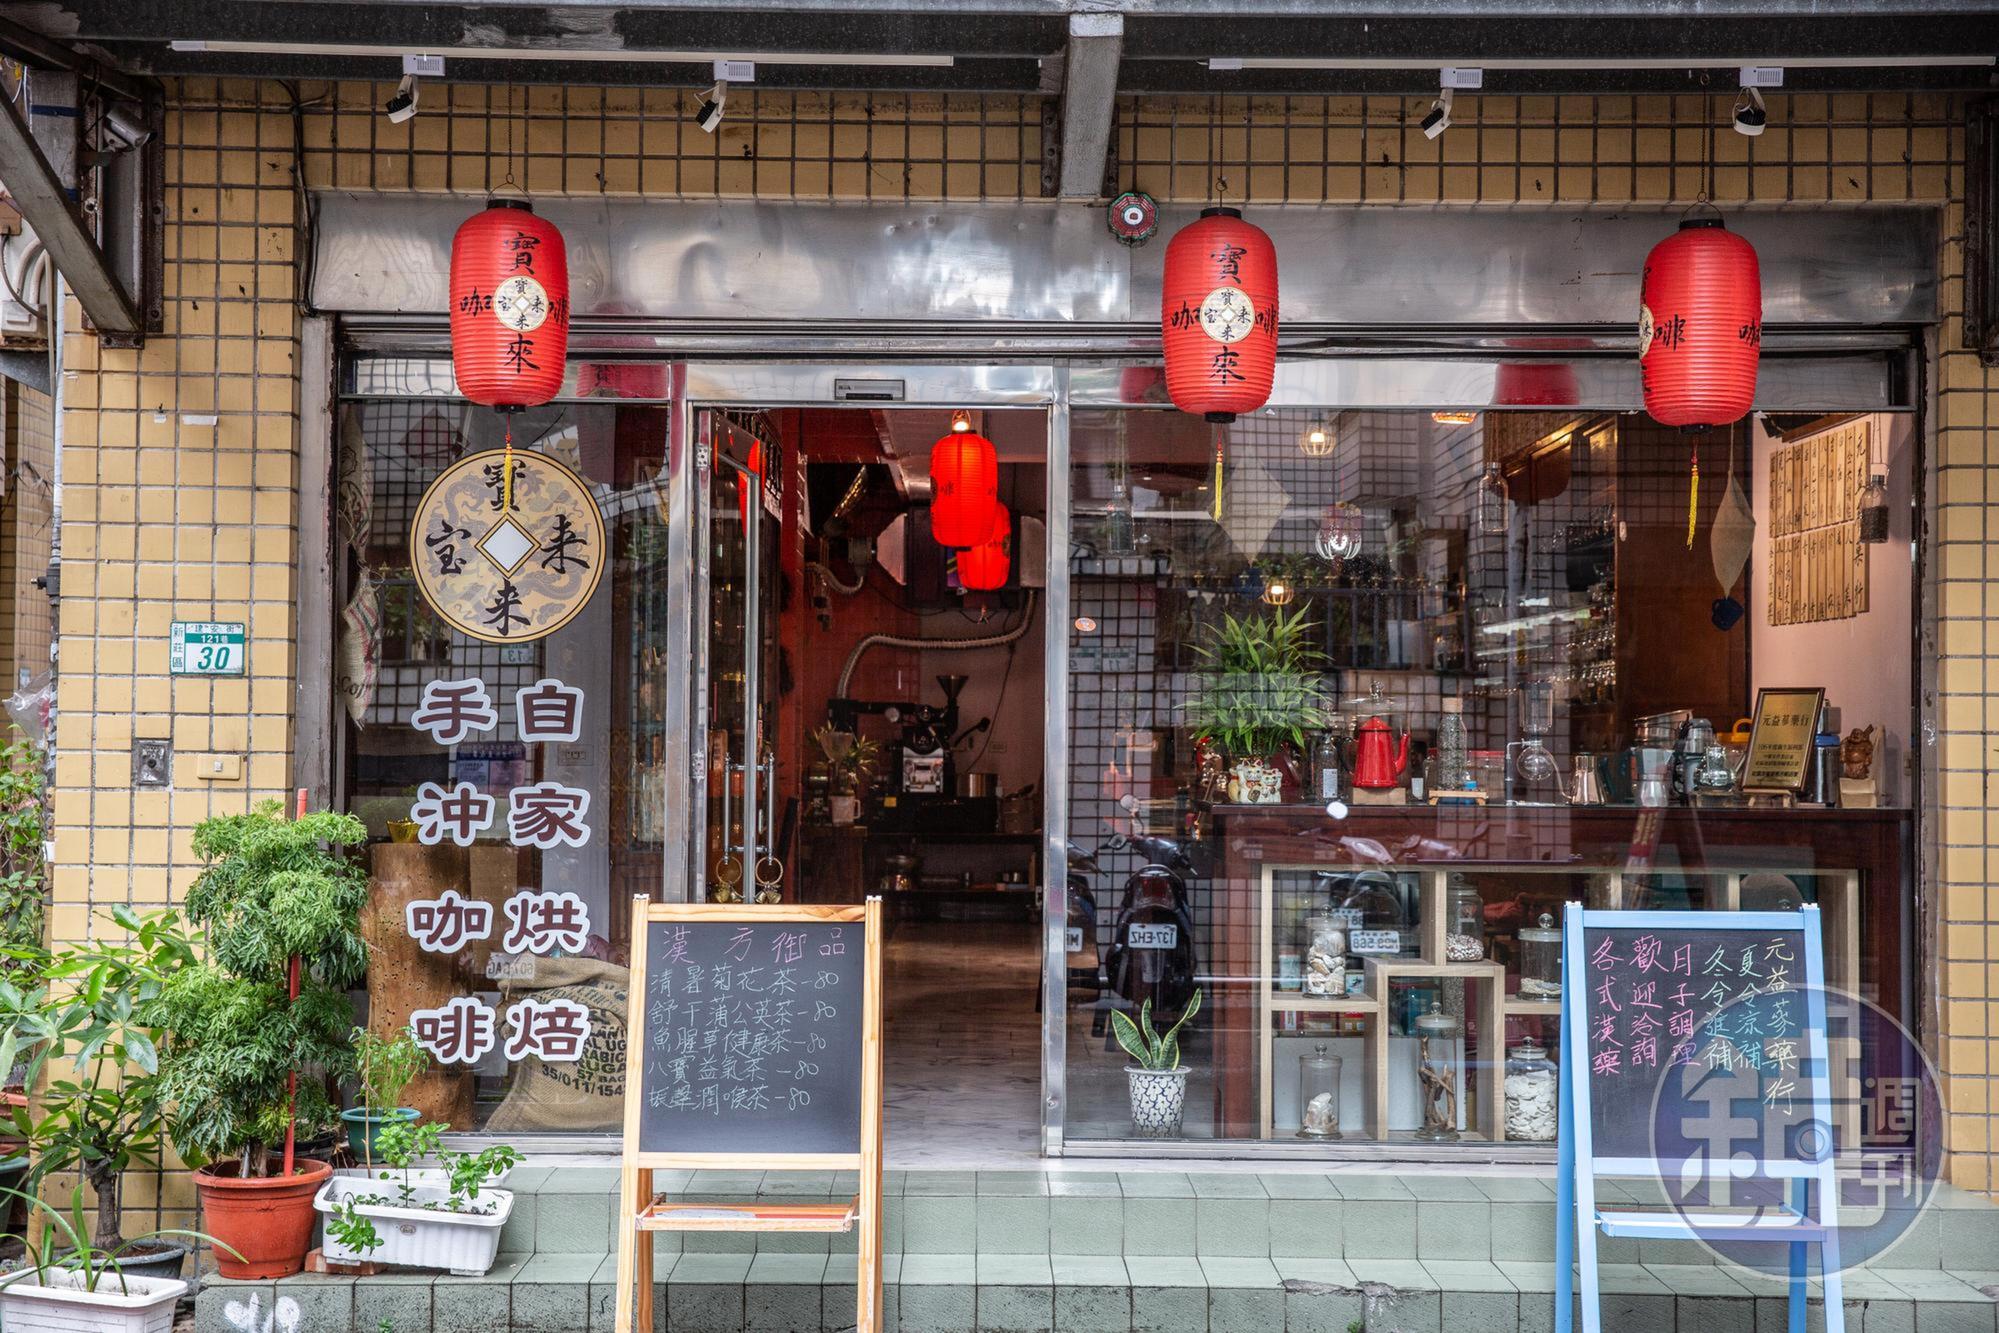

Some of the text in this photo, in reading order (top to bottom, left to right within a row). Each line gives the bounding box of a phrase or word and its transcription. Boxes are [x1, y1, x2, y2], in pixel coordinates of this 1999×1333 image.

[198, 647, 230, 670] 30
[410, 682, 493, 1060] 手沖咖啡
[506, 682, 589, 1058] 自家烘焙
